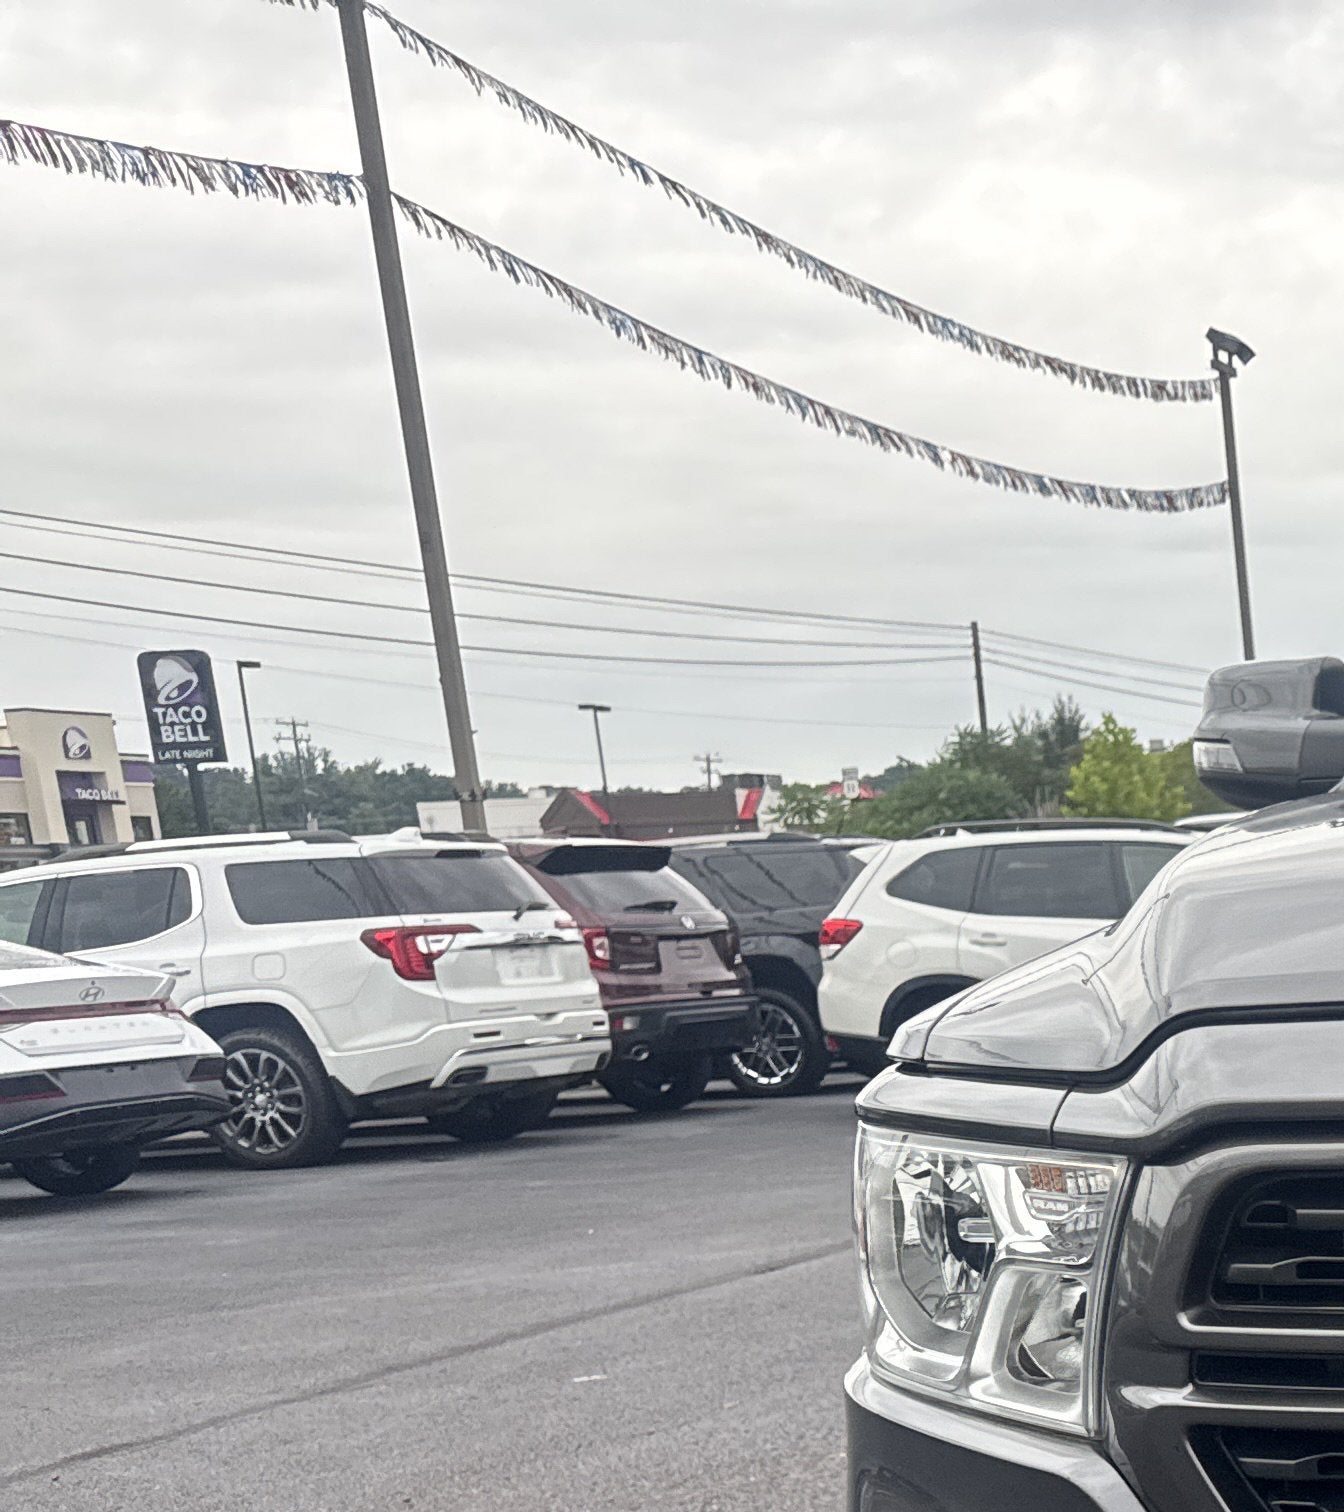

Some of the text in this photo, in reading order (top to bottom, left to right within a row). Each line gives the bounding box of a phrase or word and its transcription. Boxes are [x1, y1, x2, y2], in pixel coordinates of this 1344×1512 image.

[152, 705, 208, 724] TACO
[160, 724, 211, 743] BELL
[158, 748, 214, 760] LATE NIGHT
[75, 788, 100, 800] TACO
